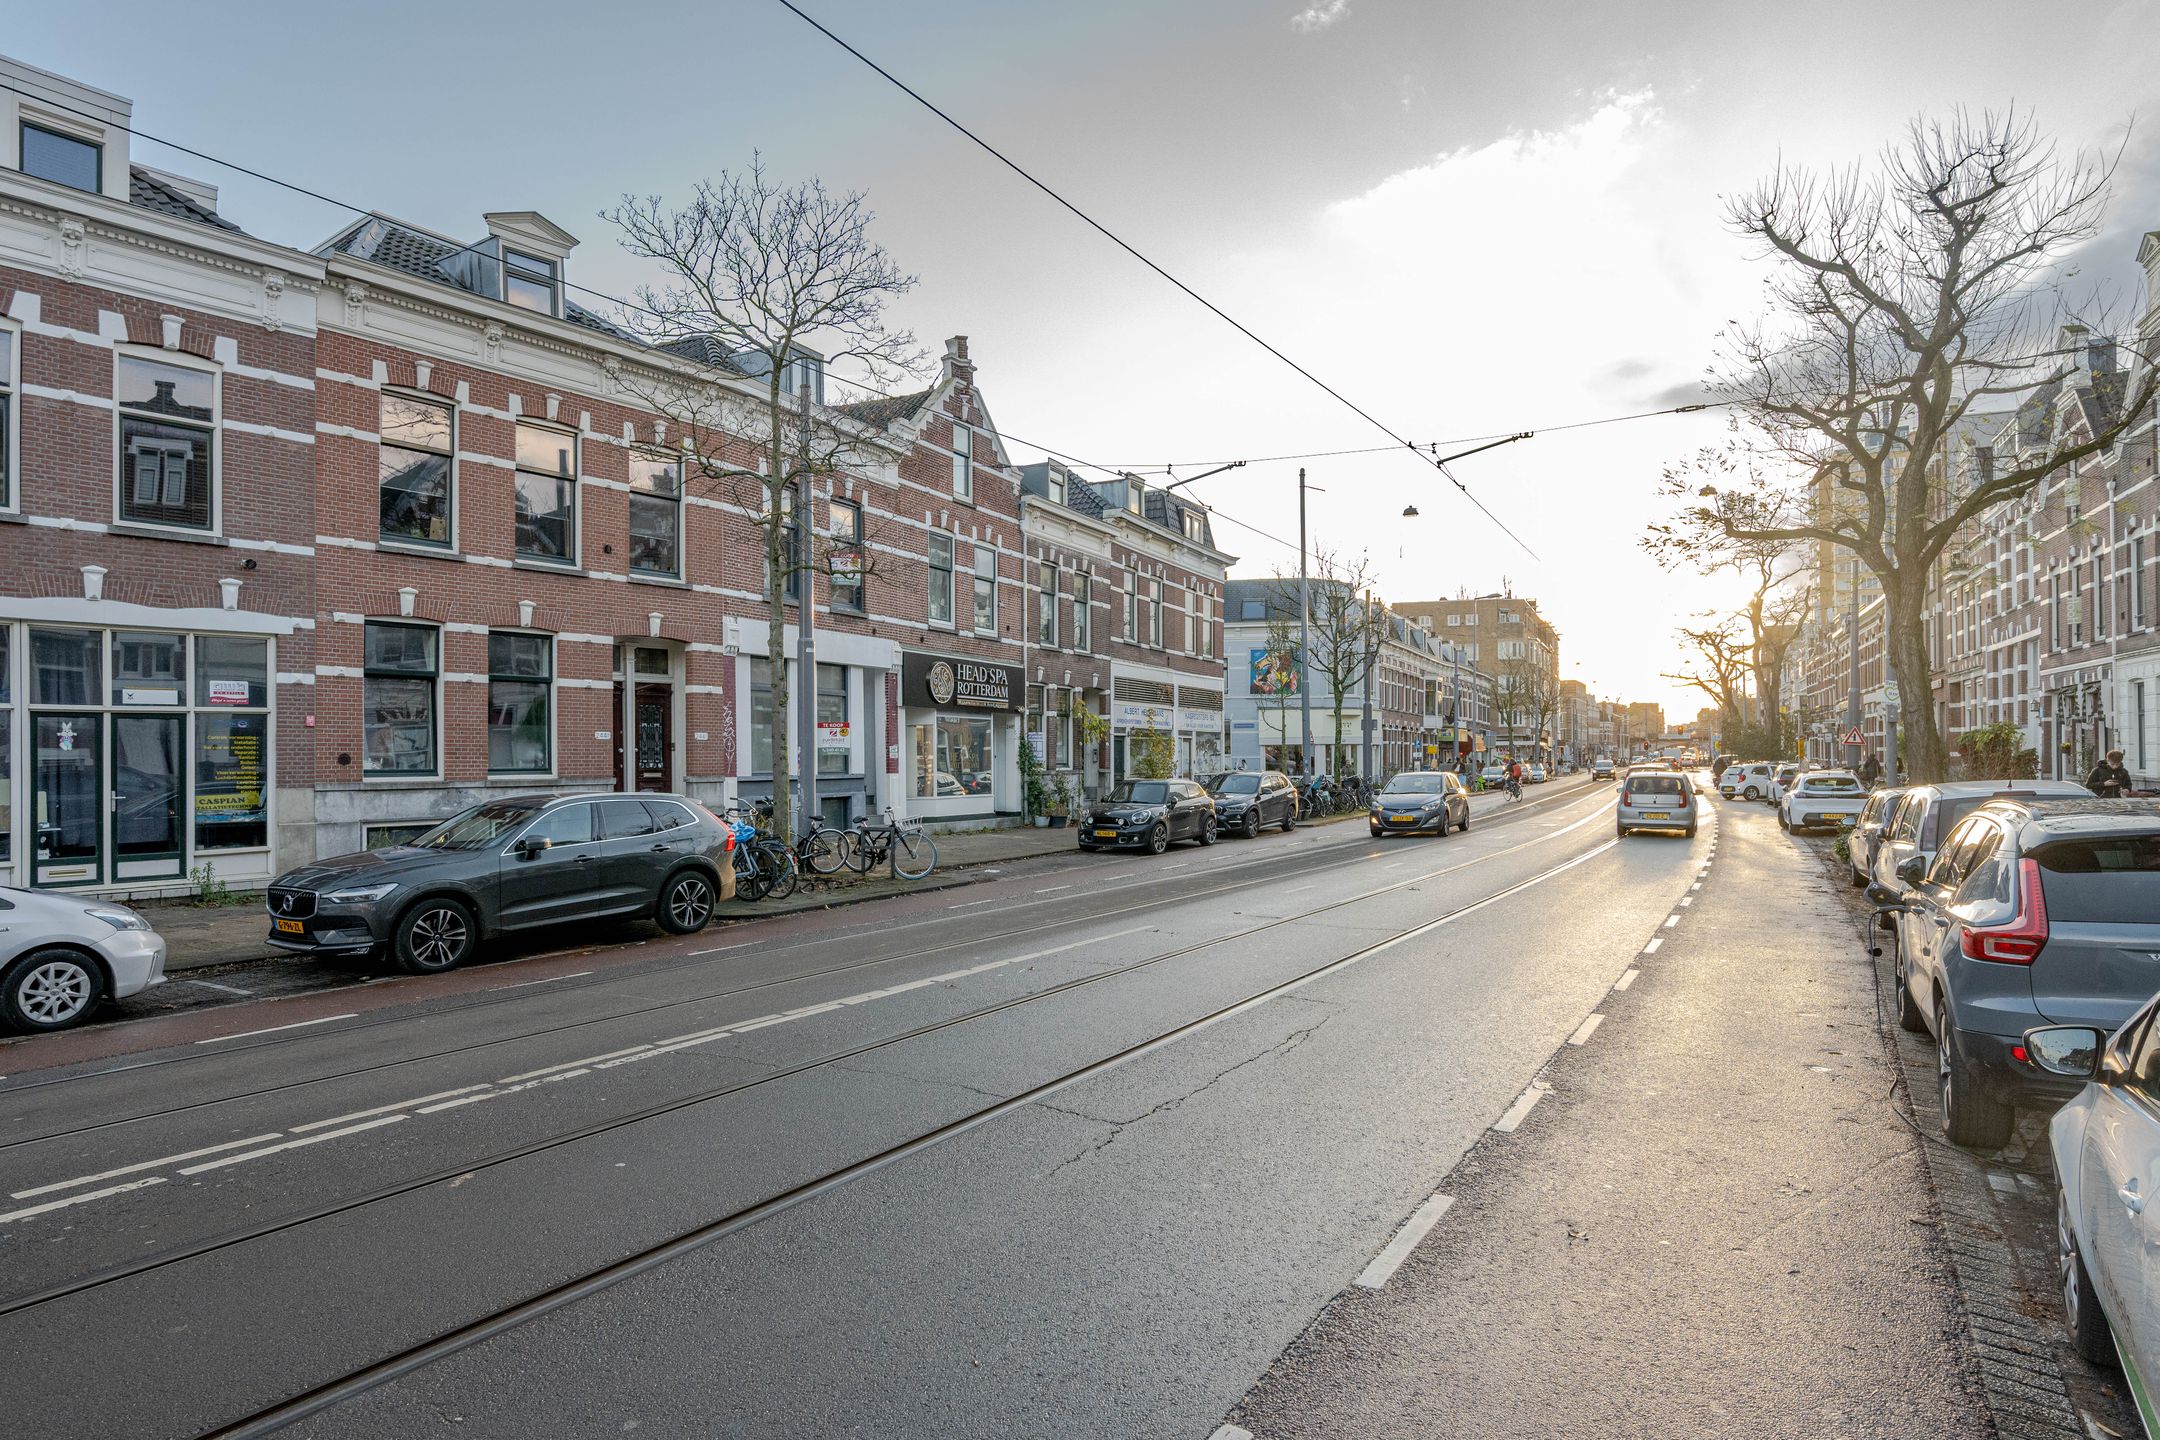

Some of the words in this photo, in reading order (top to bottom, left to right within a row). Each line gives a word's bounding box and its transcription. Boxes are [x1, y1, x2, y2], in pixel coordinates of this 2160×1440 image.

[957, 663, 988, 683] HEAD
[989, 667, 1009, 685] SPA
[957, 681, 1009, 698] ROTTERDAM
[198, 797, 246, 805] CASPIAN
